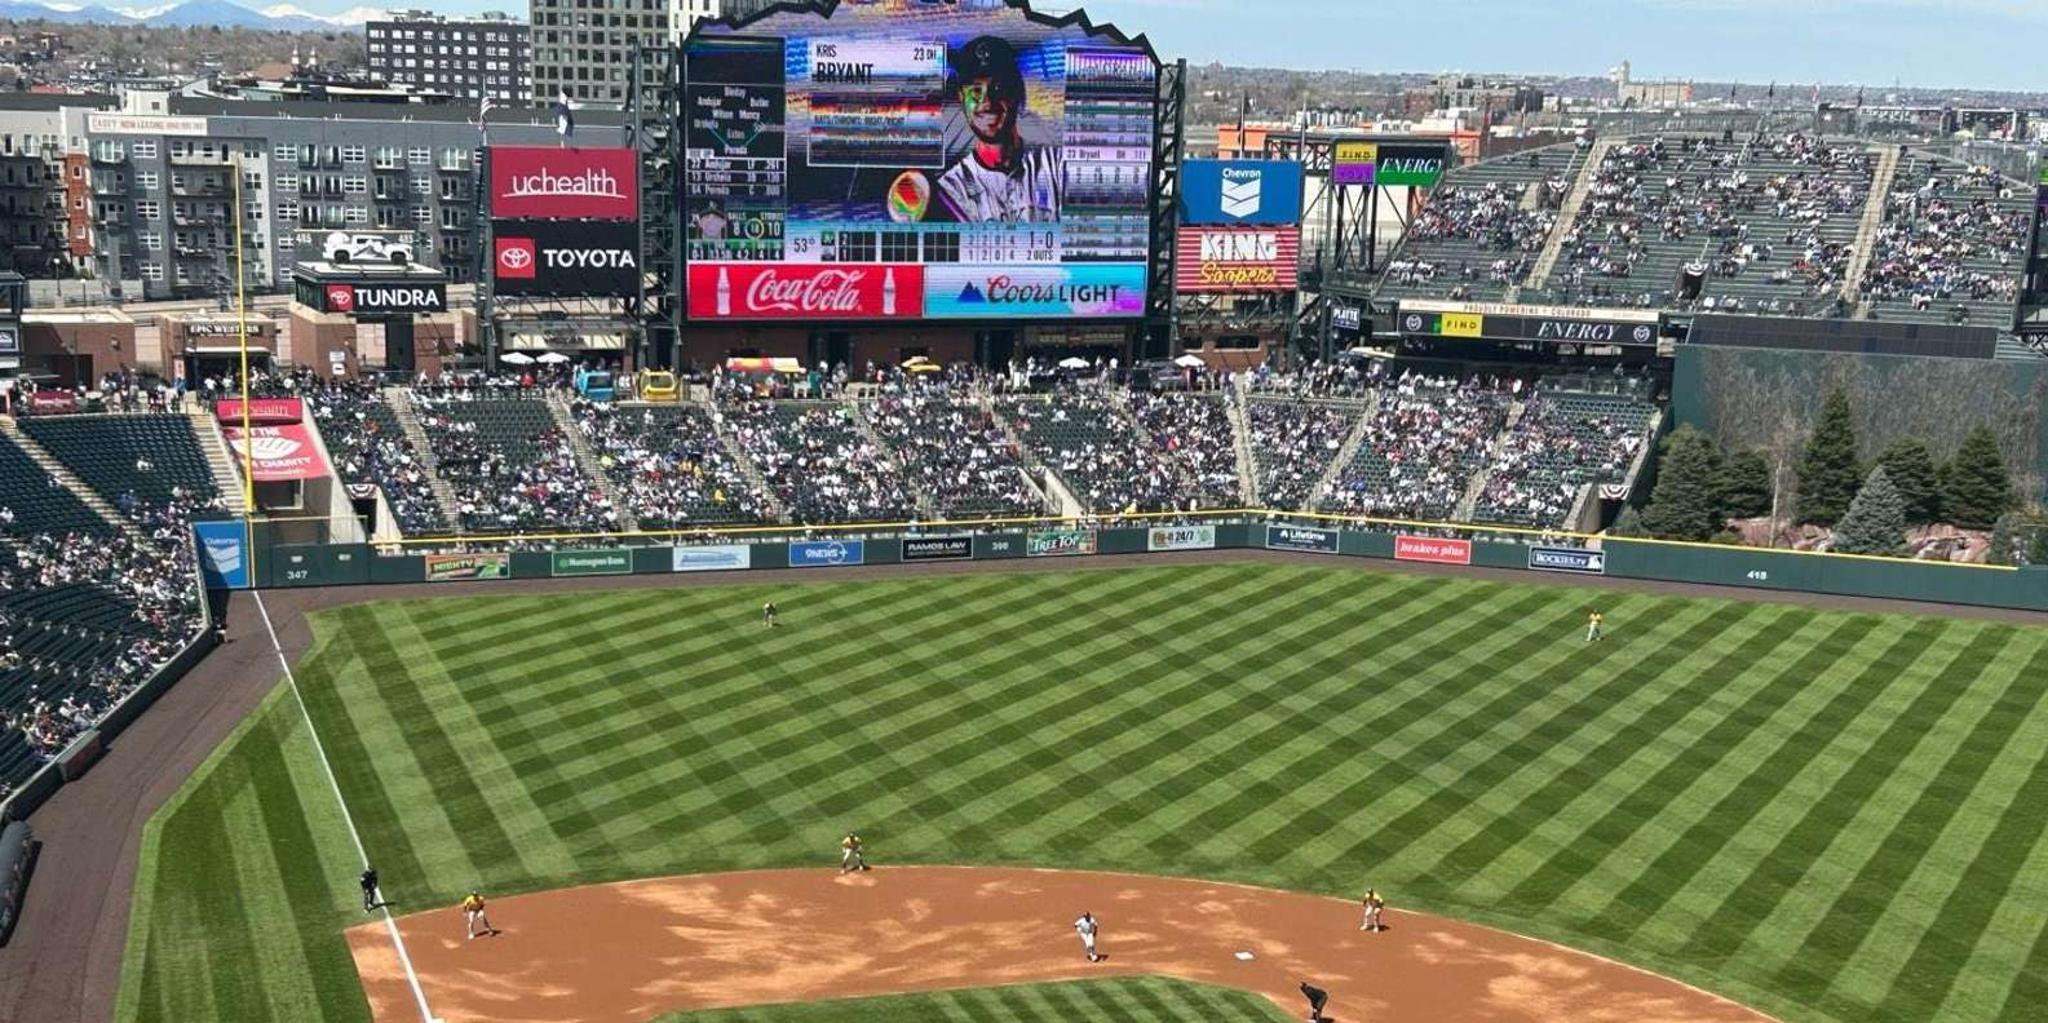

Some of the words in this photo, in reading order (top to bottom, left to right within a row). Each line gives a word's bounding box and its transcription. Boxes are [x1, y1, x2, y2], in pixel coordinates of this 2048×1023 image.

[817, 44, 837, 58] KRIS
[914, 48, 925, 61] 23
[817, 62, 874, 84] BRYANT
[1342, 150, 1372, 159] FIND
[1223, 168, 1262, 179] Chevron
[513, 167, 617, 195] uchealth
[769, 221, 782, 236] 10
[1200, 231, 1278, 261] KING
[542, 249, 636, 268] TOYOTA
[1033, 250, 1054, 262] OUTS
[1199, 262, 1277, 287] Soopers
[746, 269, 867, 311] Coca-Cola
[987, 275, 1055, 304] Coors
[1059, 284, 1120, 303] LIGHT
[354, 289, 440, 306] TUNDRA
[1447, 319, 1477, 330] FIND
[1538, 321, 1621, 341] ENERGY
[1175, 530, 1194, 542] 24/7
[1290, 530, 1326, 542] Lifetime
[805, 548, 838, 559] 9NEWS
[908, 543, 944, 552] RAMOS
[945, 541, 966, 551] LAW
[288, 570, 308, 580] 347
